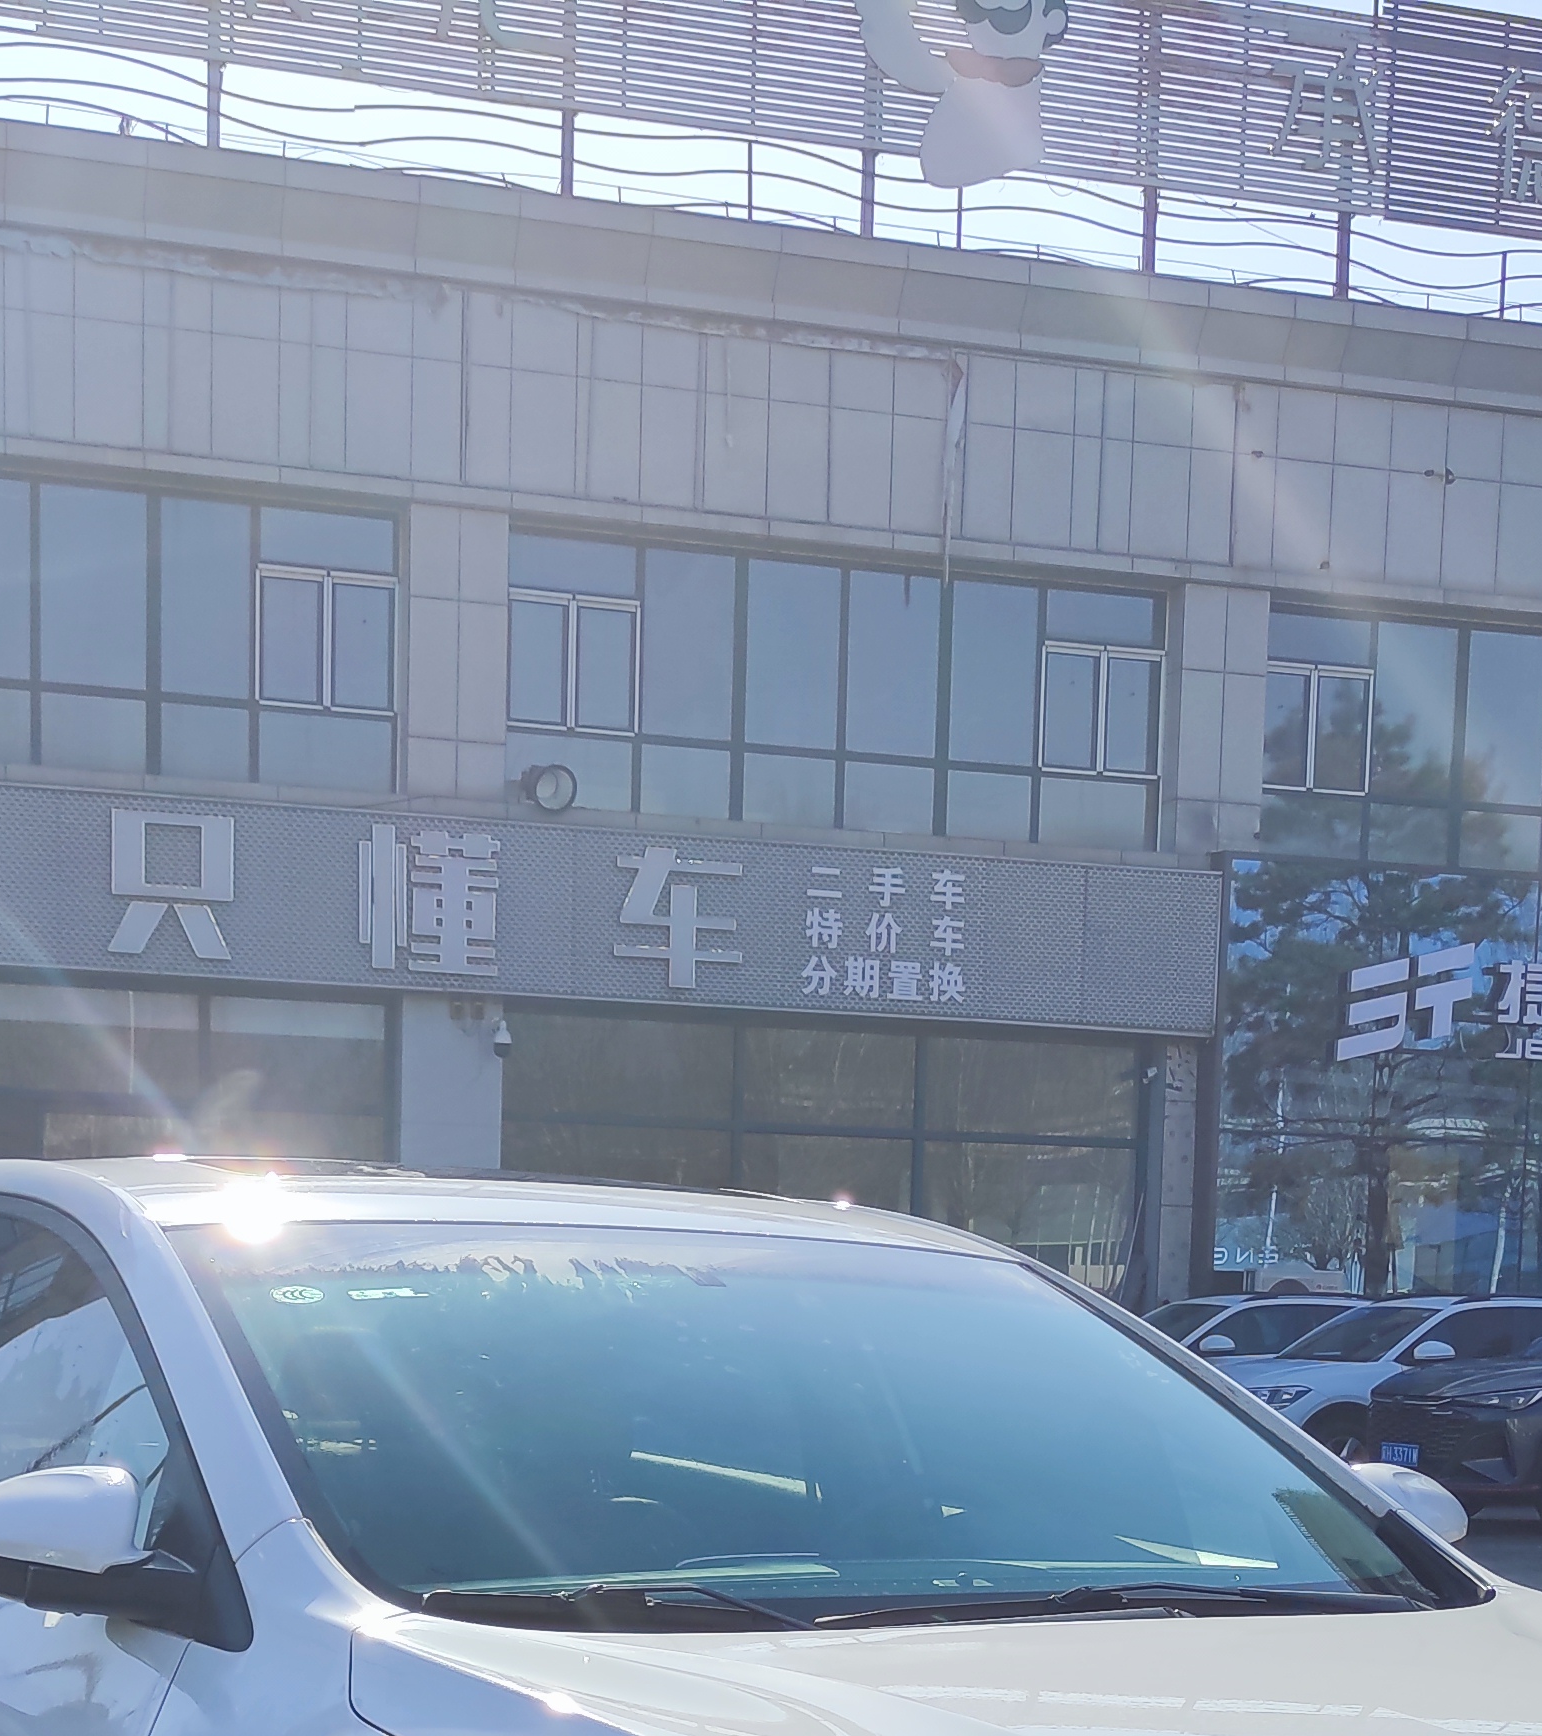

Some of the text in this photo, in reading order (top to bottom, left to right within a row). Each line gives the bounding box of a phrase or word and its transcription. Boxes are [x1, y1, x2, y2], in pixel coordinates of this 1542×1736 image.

[806, 866, 966, 910] 二手车
[805, 907, 965, 956] 特价车
[801, 955, 966, 1003] 分期置换
